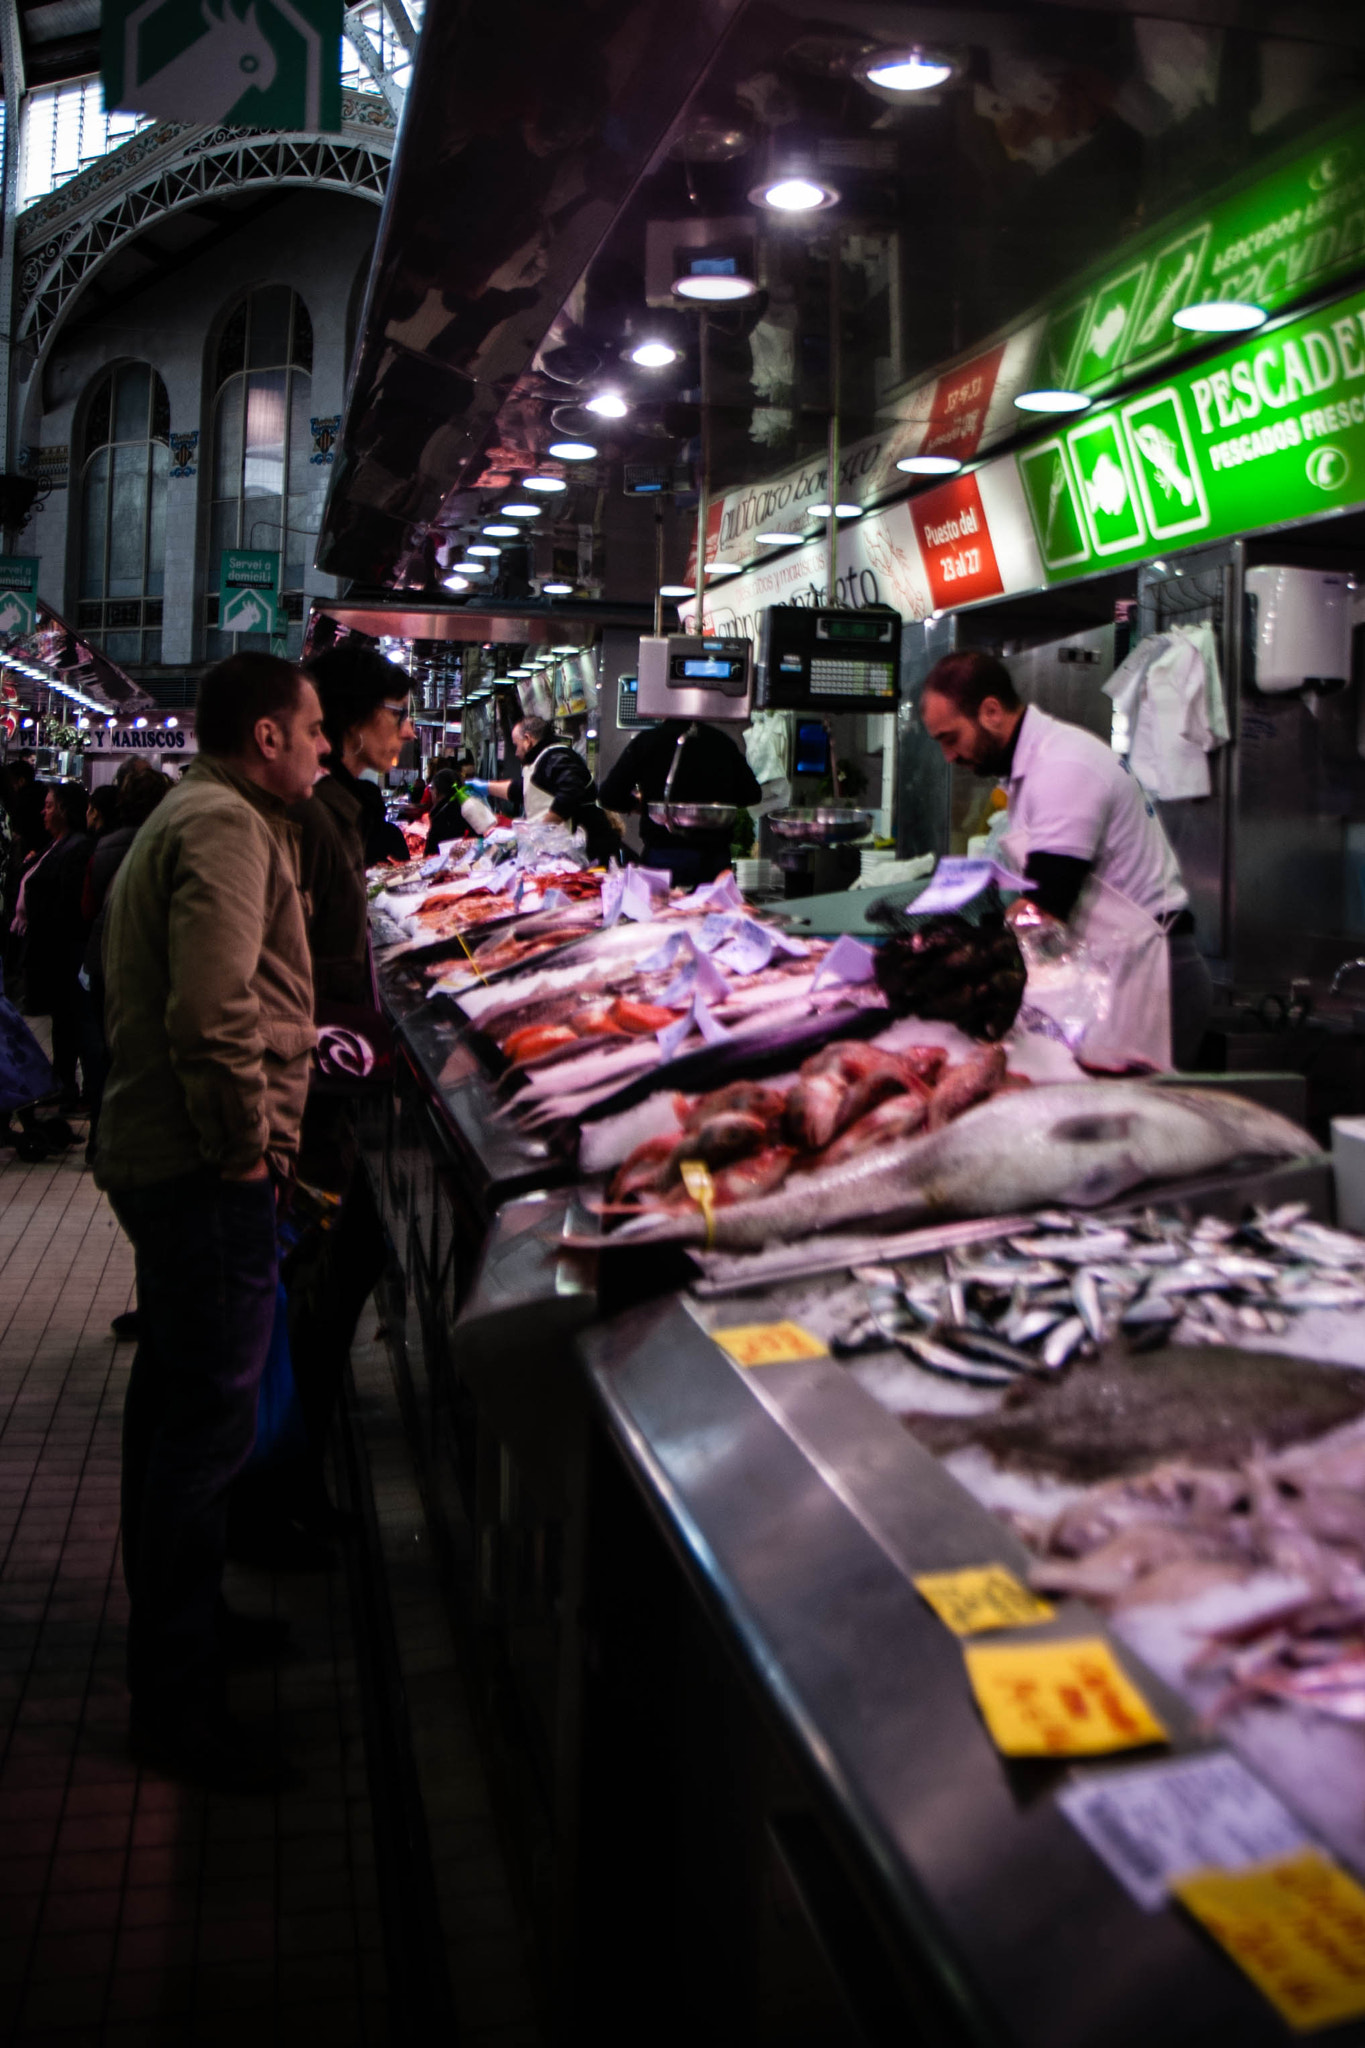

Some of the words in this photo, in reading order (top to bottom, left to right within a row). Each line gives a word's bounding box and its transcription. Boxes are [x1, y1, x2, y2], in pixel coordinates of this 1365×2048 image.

[1190, 310, 1365, 434] PESCADE
[1209, 418, 1301, 471] PESCADOS
[924, 520, 960, 548] Puesto
[960, 507, 978, 535] del
[229, 557, 262, 570] Servei
[264, 562, 271, 570] a
[940, 557, 956, 581] 23
[955, 552, 967, 577] al
[965, 548, 979, 574] 27
[95, 731, 105, 747] Y
[111, 731, 185, 748] MARISCOS
